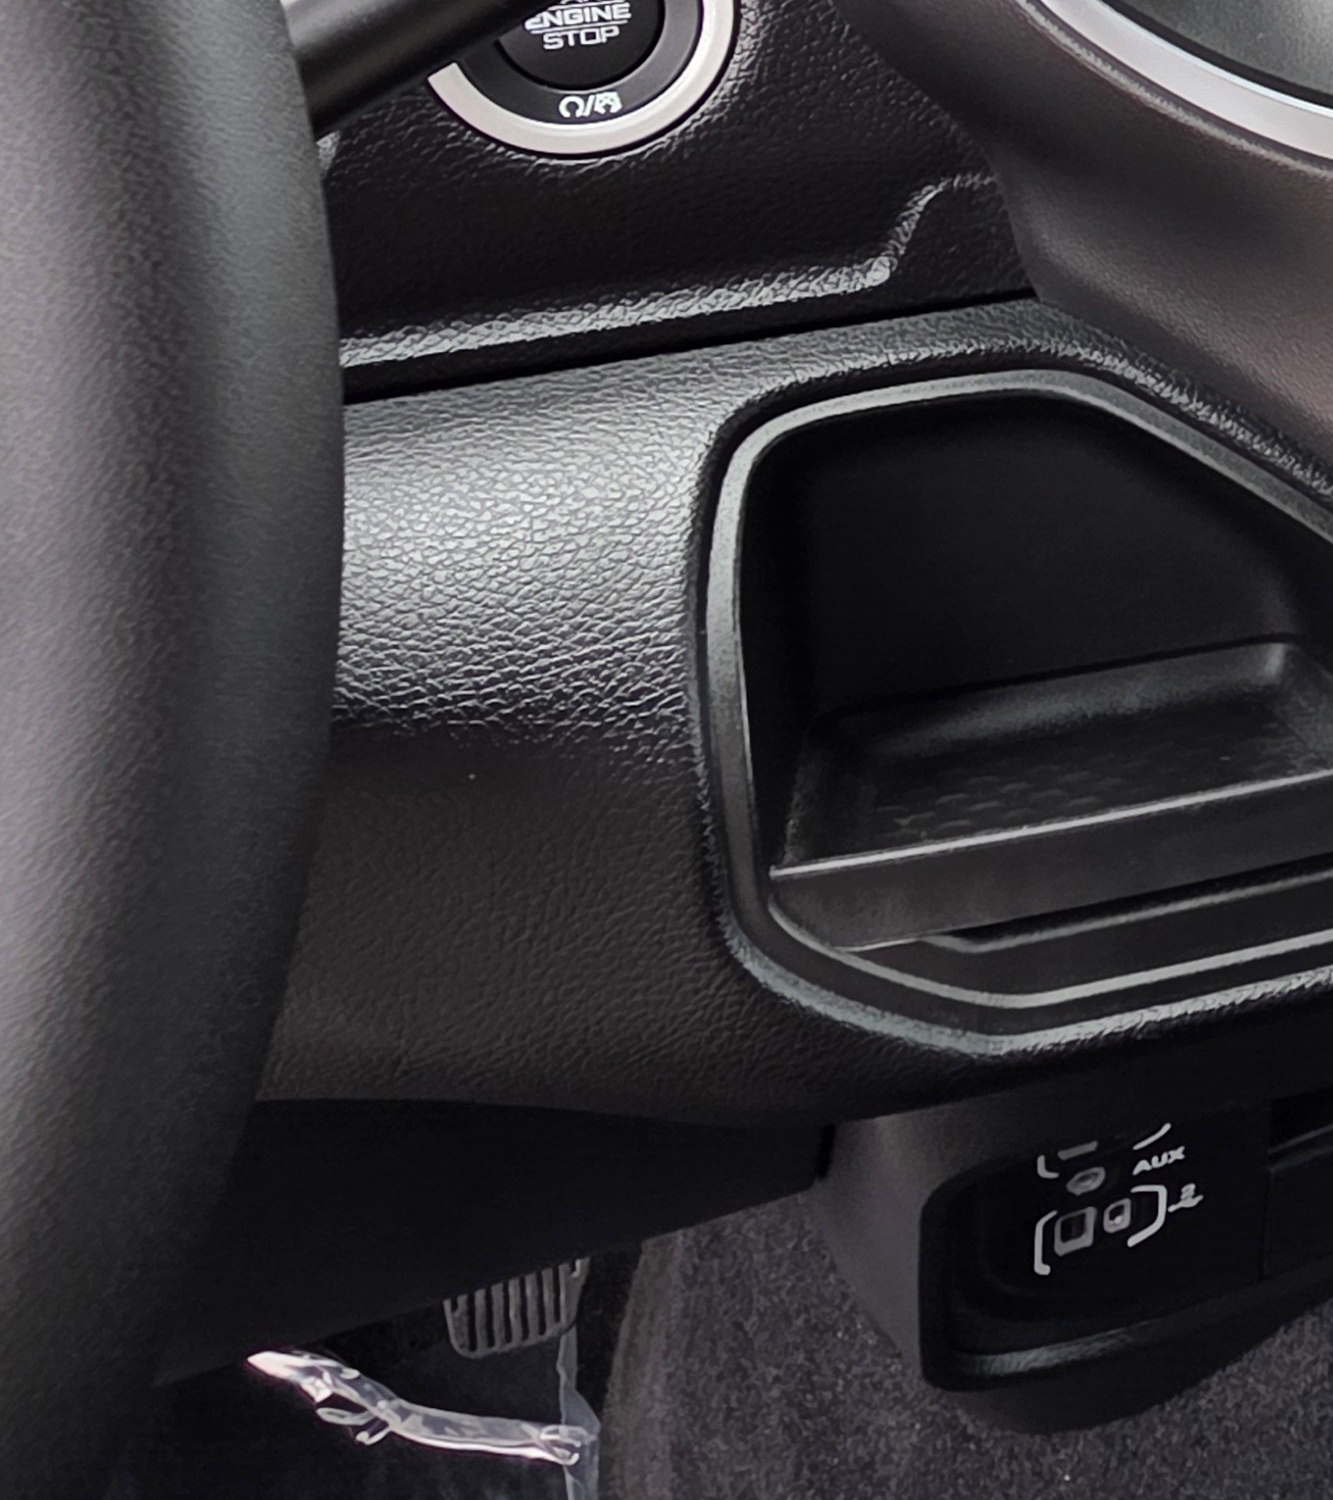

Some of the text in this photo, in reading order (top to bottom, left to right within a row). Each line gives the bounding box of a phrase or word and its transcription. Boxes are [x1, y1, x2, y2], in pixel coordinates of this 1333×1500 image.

[524, 2, 632, 31] ENGINE
[543, 25, 620, 50] STOP
[1132, 1145, 1186, 1176] AUX
